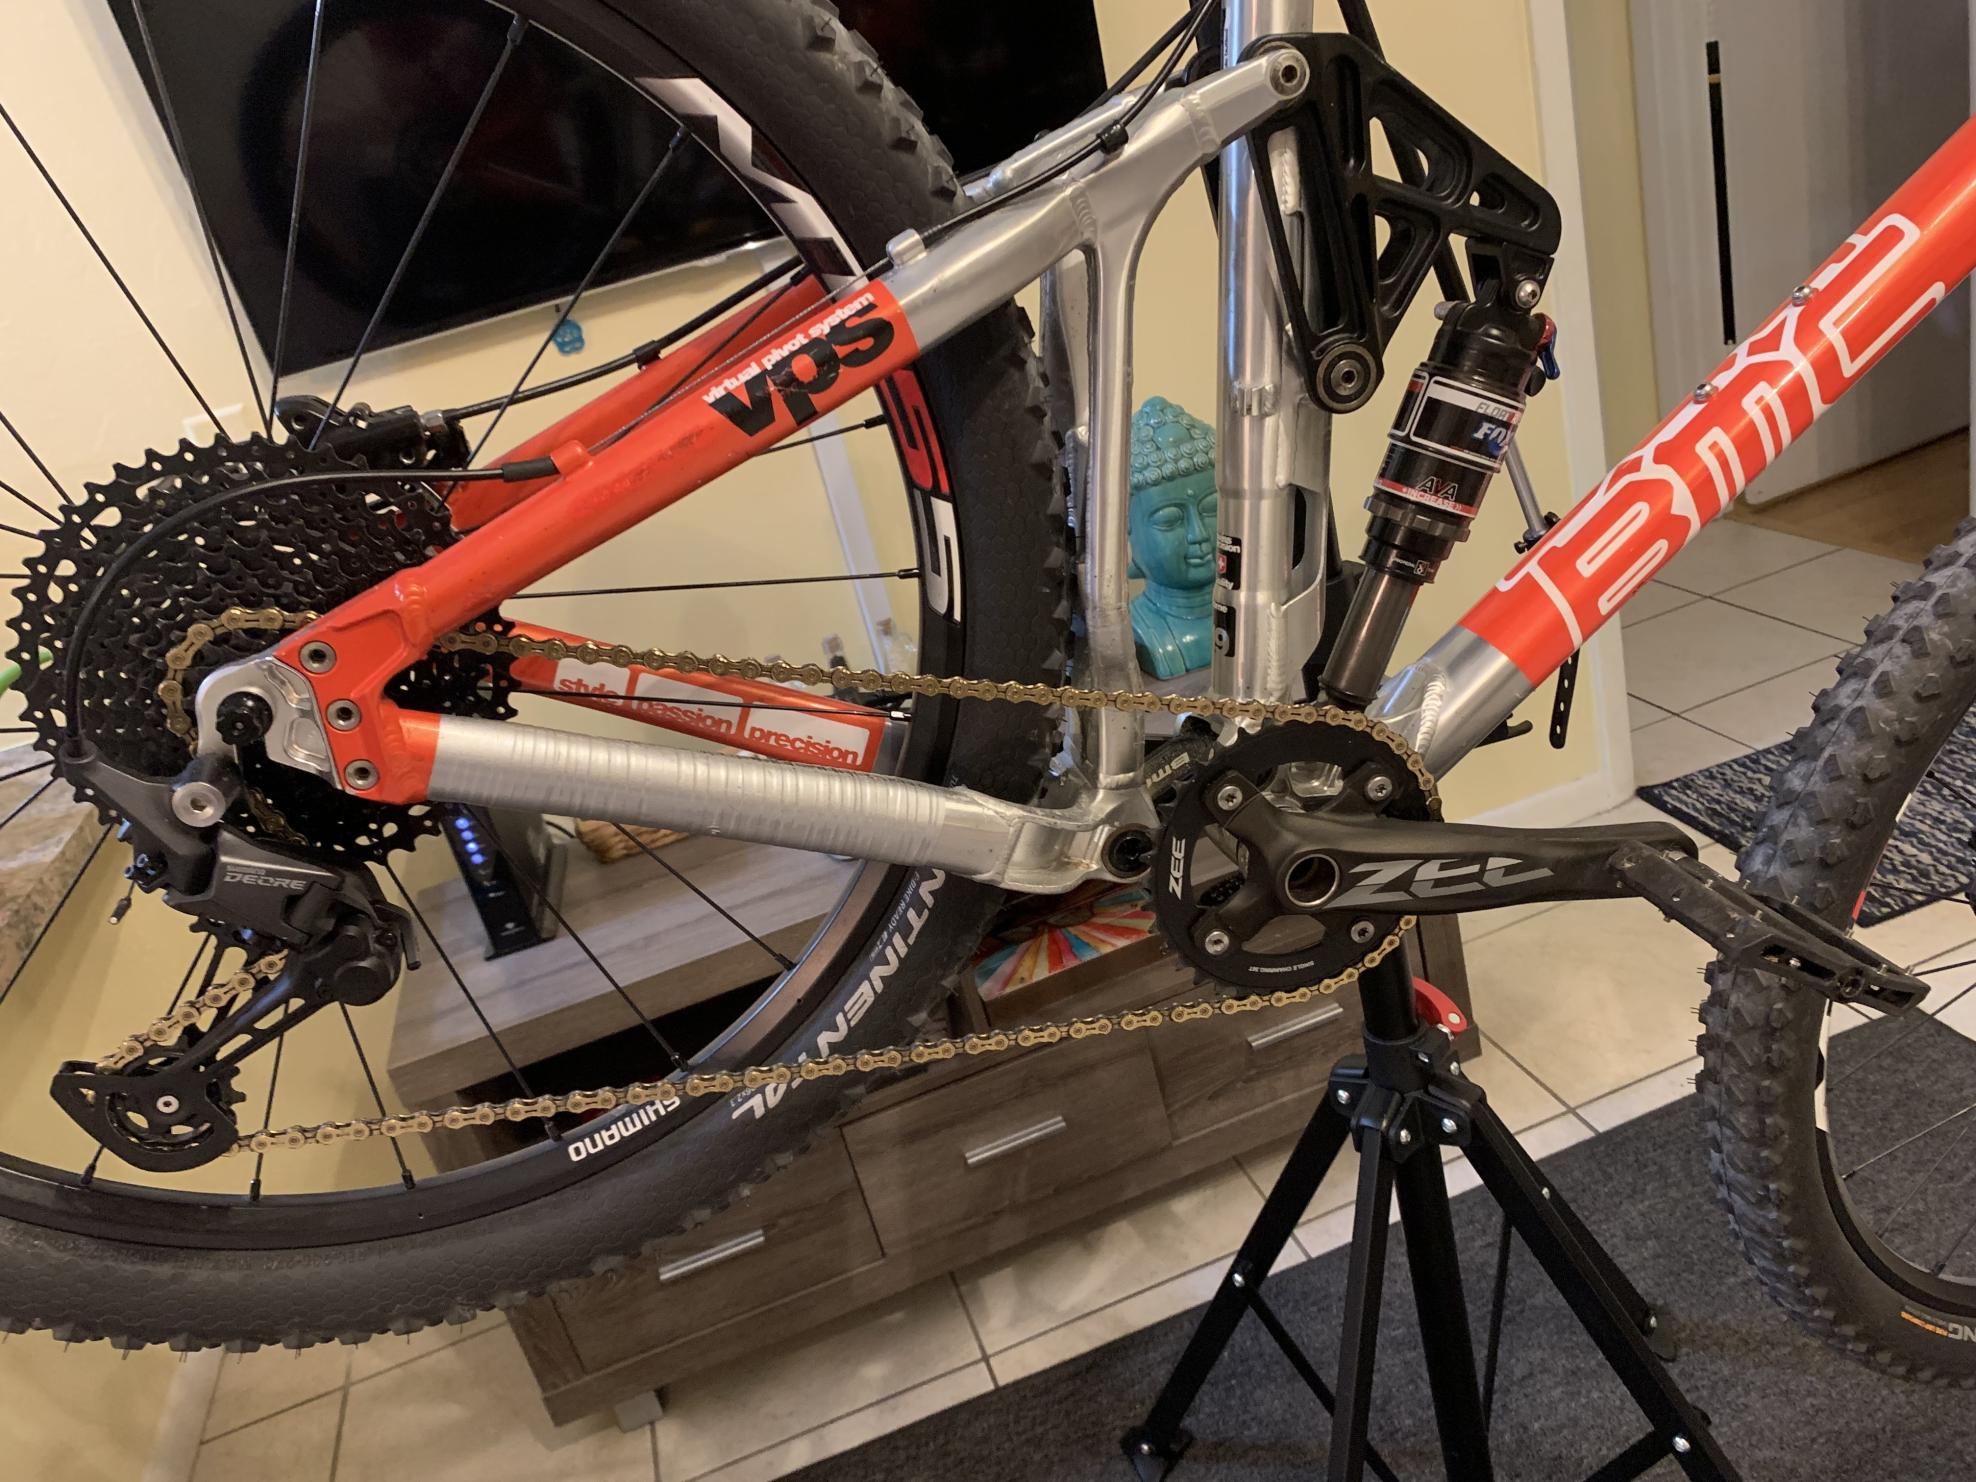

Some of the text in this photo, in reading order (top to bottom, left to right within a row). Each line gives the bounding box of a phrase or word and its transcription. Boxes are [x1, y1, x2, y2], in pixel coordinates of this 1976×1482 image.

[702, 292, 875, 404] virtual pivot system
[750, 725, 861, 766] precision
[223, 872, 307, 890] DEORE
[1168, 837, 1186, 900] ZEE
[567, 1095, 681, 1162] SHIMANO
